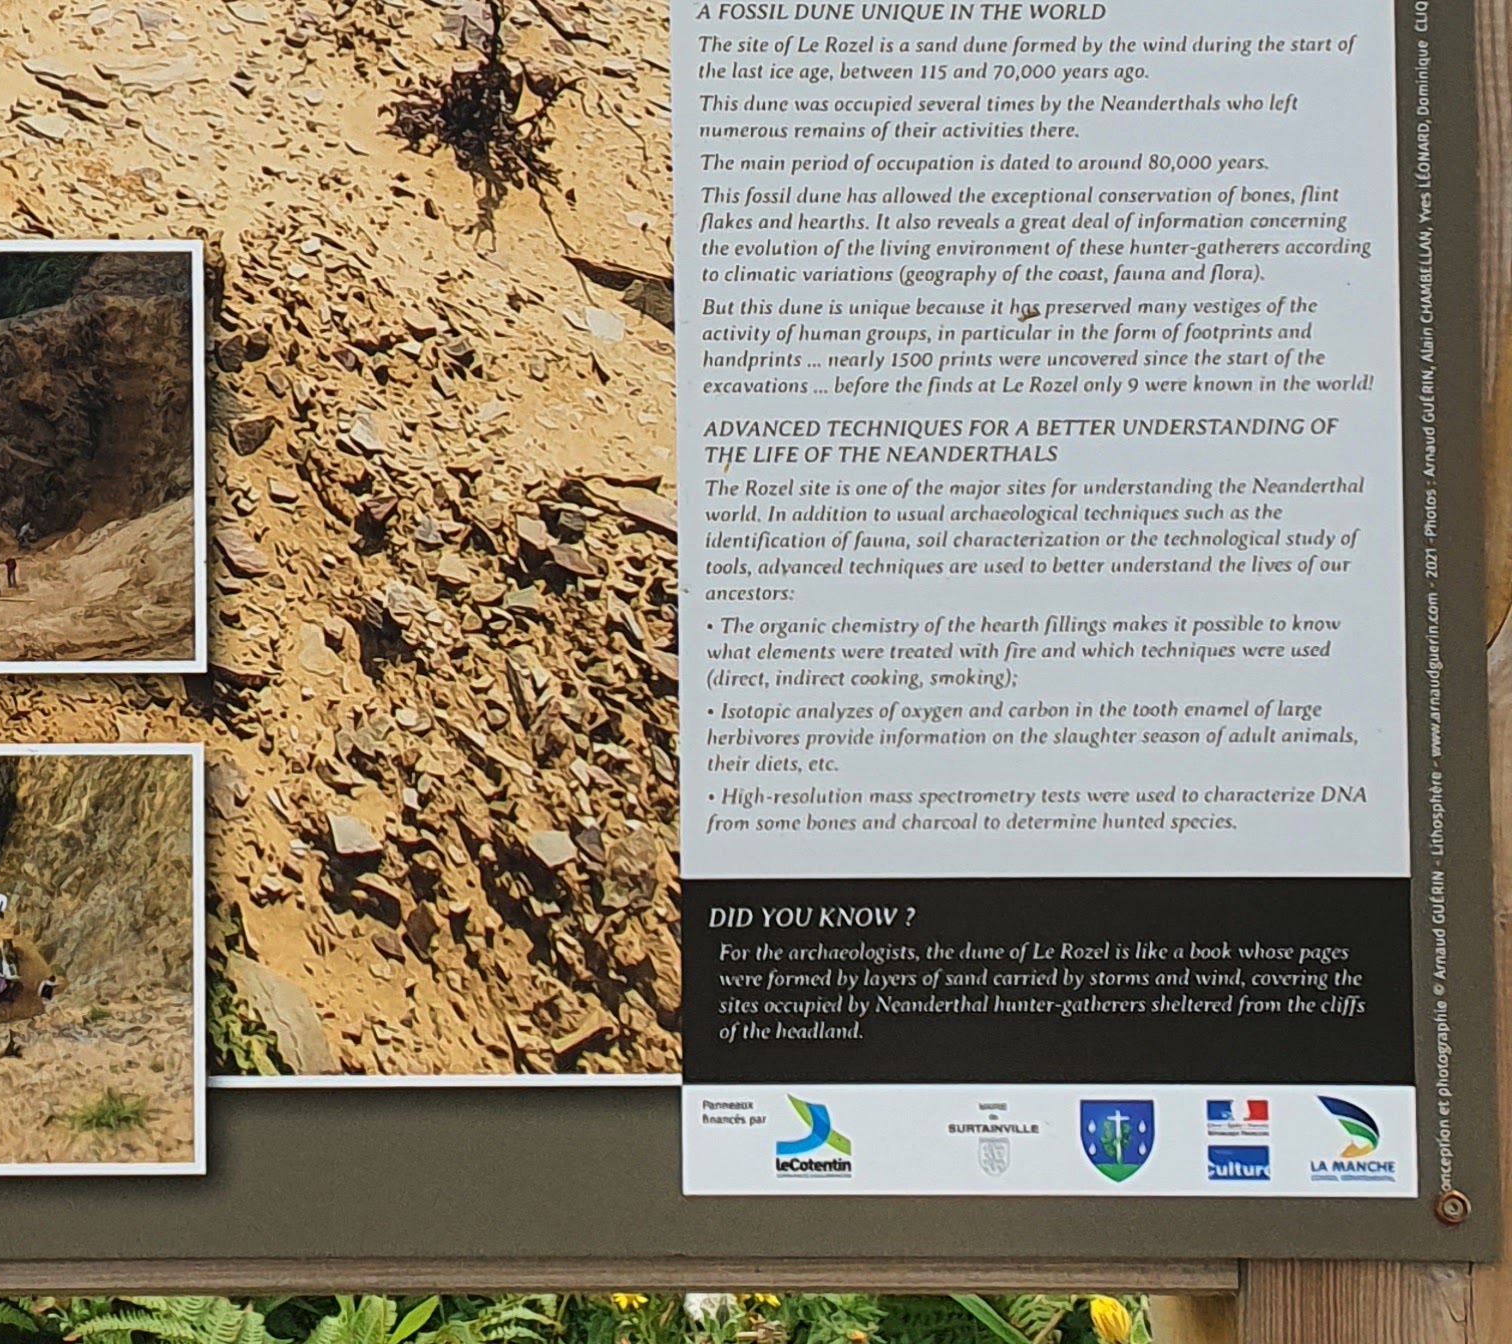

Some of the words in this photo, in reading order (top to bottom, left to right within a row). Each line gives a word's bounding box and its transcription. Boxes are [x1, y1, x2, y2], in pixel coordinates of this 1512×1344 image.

[696, 3, 710, 19] A
[718, 3, 788, 20] FOSSIL
[794, 3, 855, 20] DUNE
[862, 3, 944, 23] UNIQUE
[950, 3, 974, 20] IN
[980, 3, 1022, 20] THE
[1029, 3, 1106, 20] WORLD
[703, 420, 820, 437] ADVANCED
[827, 419, 963, 439] TECHNIQUES
[968, 419, 1009, 436] FOR
[1015, 420, 1029, 436] A
[1036, 419, 1115, 436] BETTER
[1123, 418, 1304, 435] UNDERSTANDING
[1310, 417, 1339, 434] OF
[704, 446, 747, 462] THE
[753, 446, 799, 463] LIFE
[804, 446, 833, 463] OF
[838, 446, 880, 463] THE
[886, 445, 1058, 462] NEANDERTHALS
[1424, 593, 1445, 758] www.arnaudguerin.com
[709, 907, 753, 927] DID
[761, 907, 812, 927] YOU
[818, 907, 898, 927] KNOW
[719, 1021, 740, 1043] of
[742, 1021, 770, 1039] the
[775, 1020, 863, 1039] headland.
[948, 1124, 1040, 1133] SURTAINVILLE
[776, 1157, 852, 1172] leCotentin
[1435, 1120, 1453, 1191] onception
[1311, 1160, 1328, 1172] LA
[1332, 1160, 1396, 1173] MANCHE
